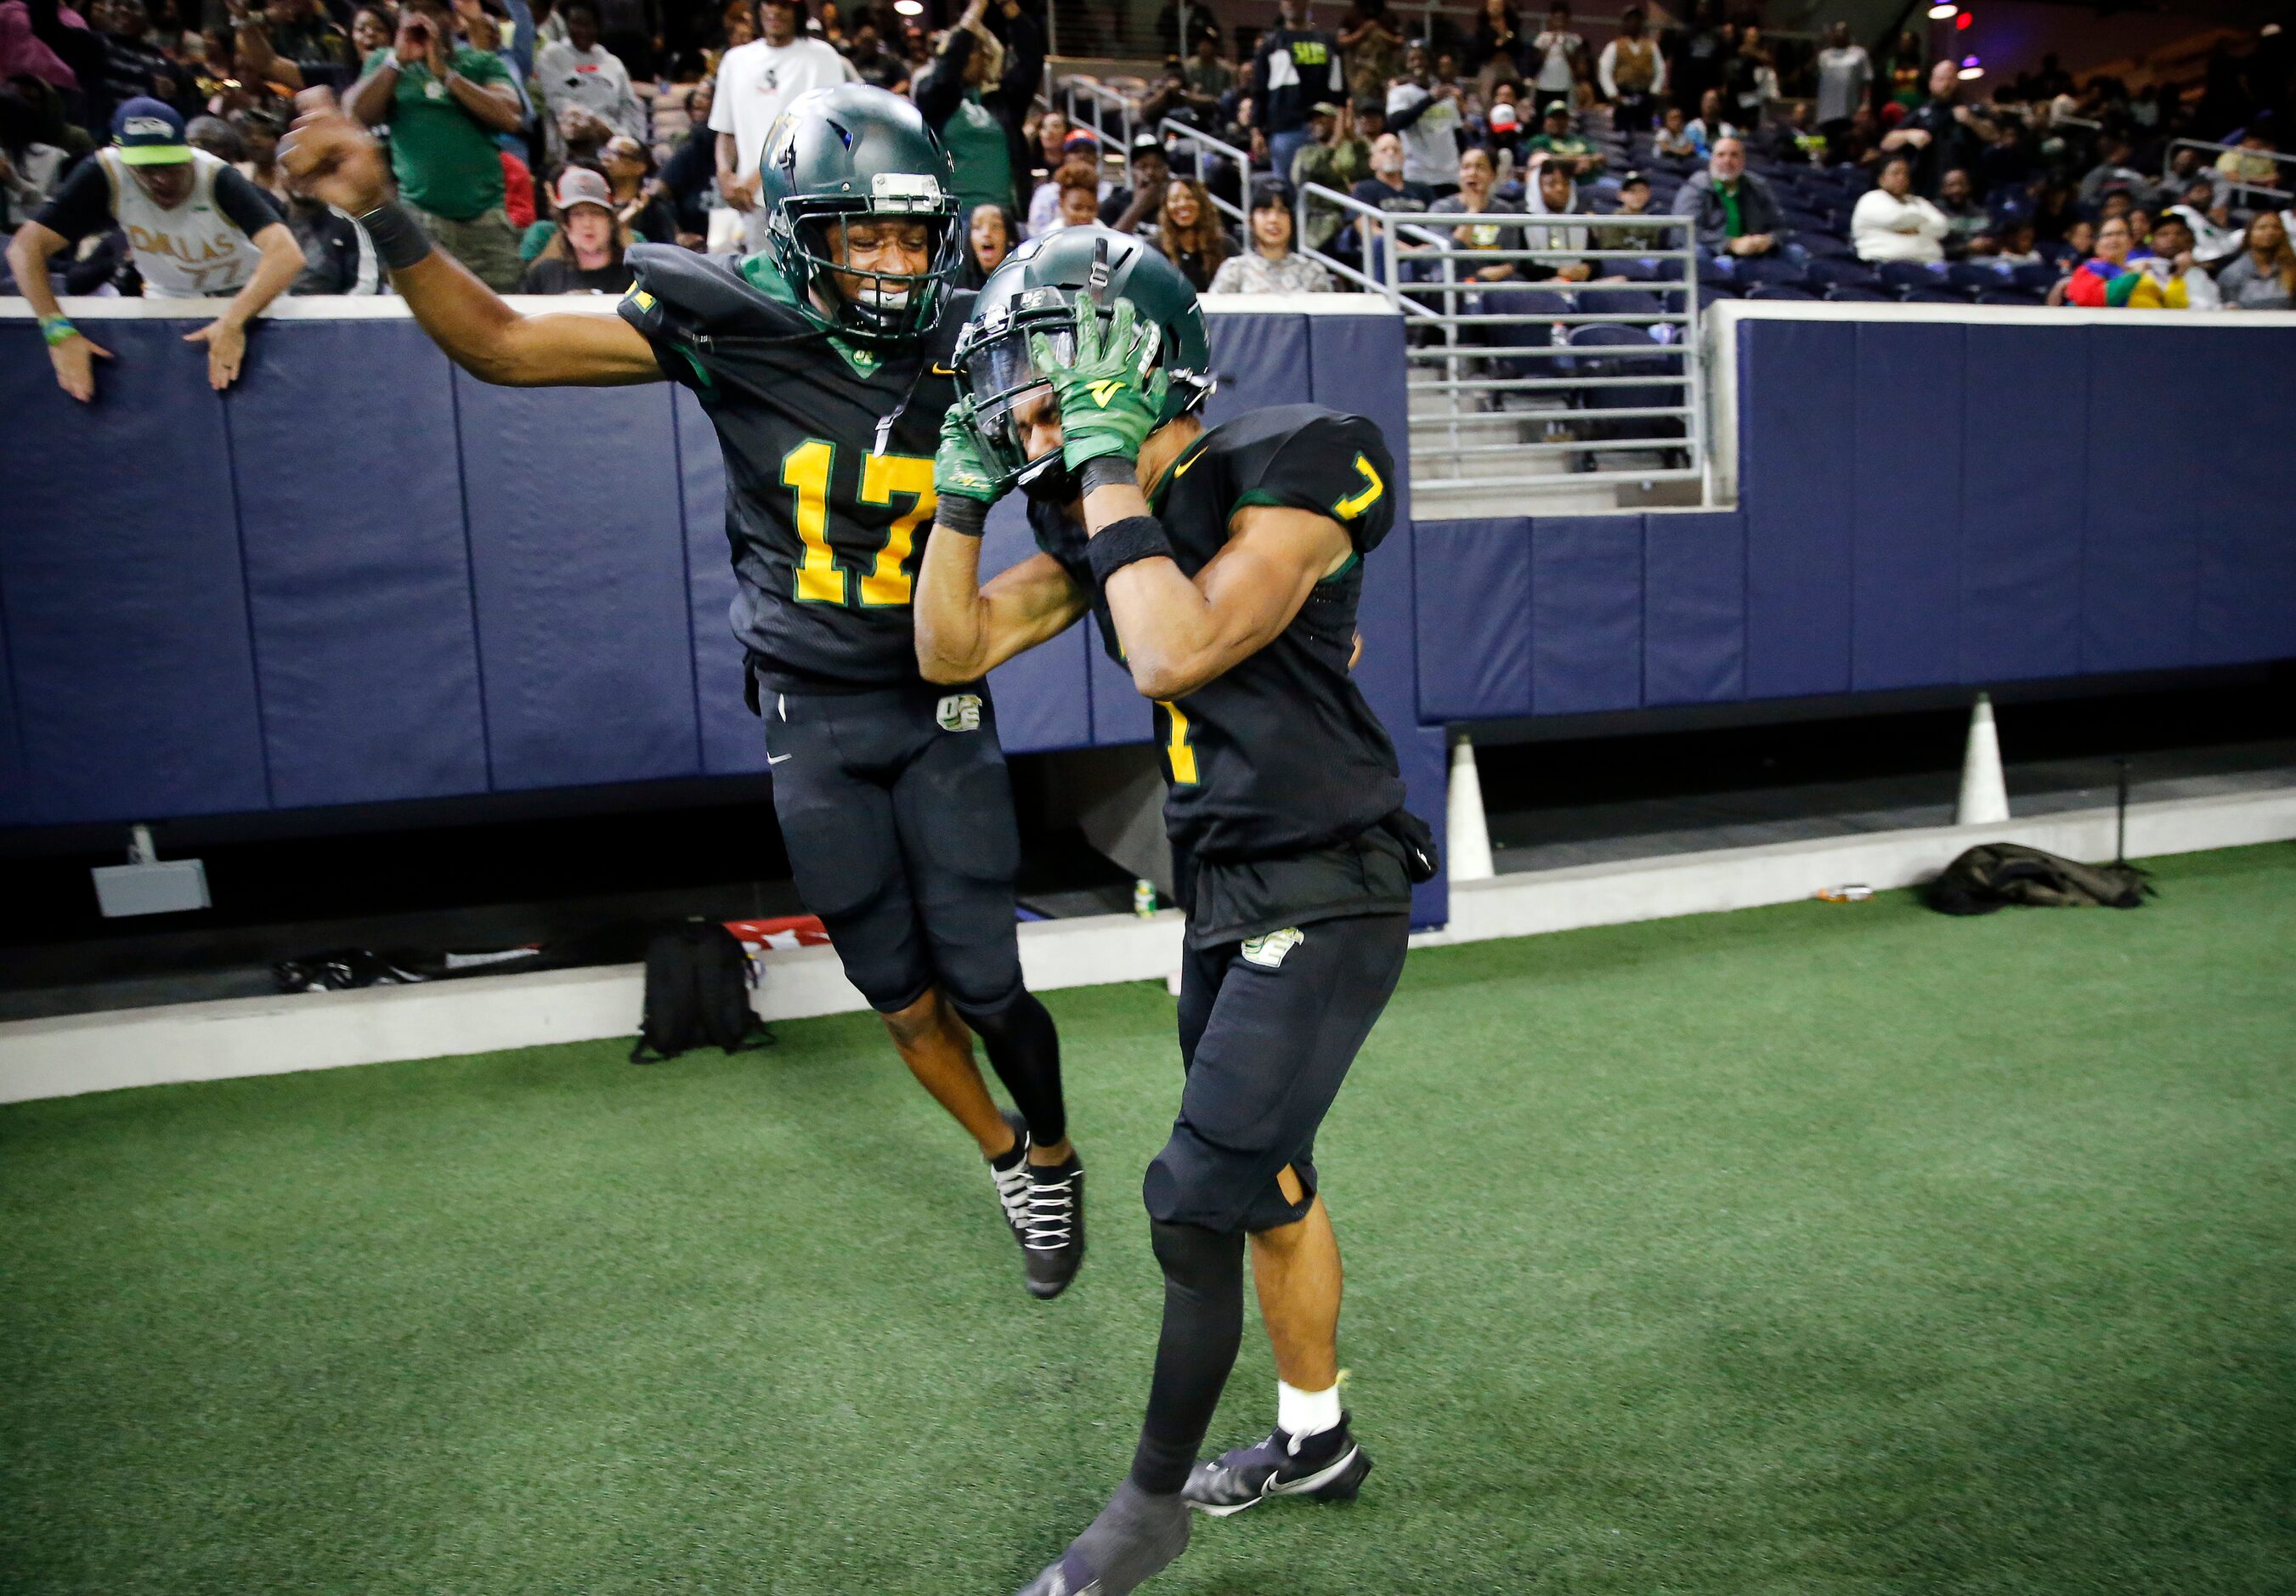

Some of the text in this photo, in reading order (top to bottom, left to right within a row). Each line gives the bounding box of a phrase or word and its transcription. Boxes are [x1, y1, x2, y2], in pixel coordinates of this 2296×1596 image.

[129, 224, 236, 263] DALLAS
[178, 258, 241, 290] 77
[1330, 450, 1384, 521] 7
[779, 437, 938, 608] 17
